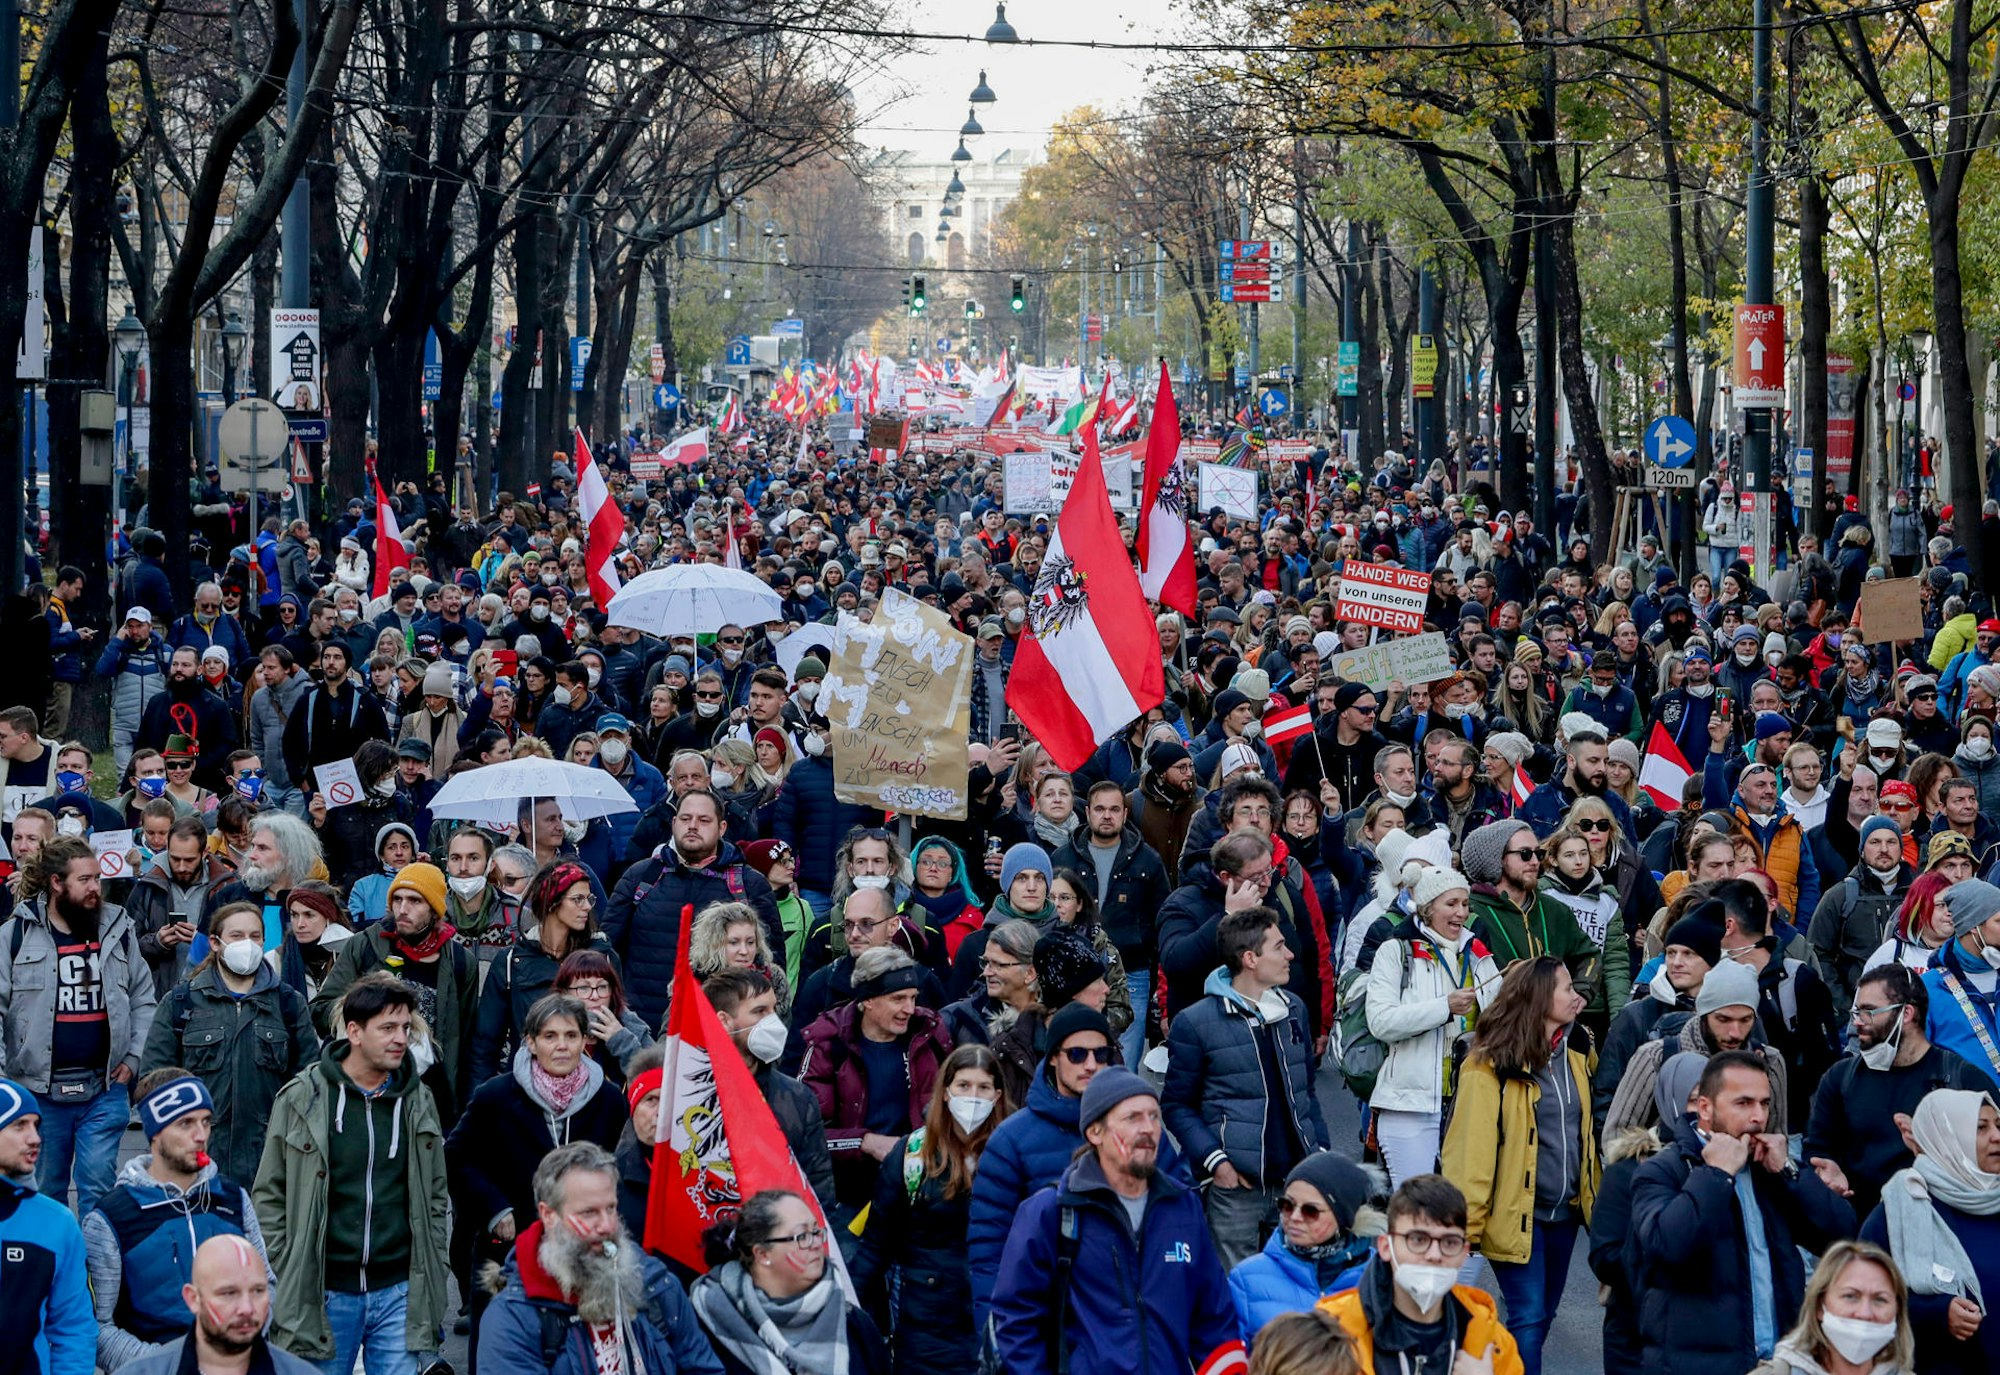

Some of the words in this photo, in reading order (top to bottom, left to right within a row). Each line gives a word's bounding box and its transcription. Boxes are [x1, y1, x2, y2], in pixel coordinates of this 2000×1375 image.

[1739, 309, 1775, 324] PRATER
[294, 339, 310, 347] AUF
[578, 345, 592, 365] P
[733, 345, 744, 360] P
[293, 369, 311, 377] WEG
[290, 426, 321, 436] bastraße
[1652, 470, 1689, 485] 120m
[1345, 563, 1394, 583] HÄNDE
[1397, 572, 1429, 589] WEG
[1344, 587, 1367, 598] von
[1371, 591, 1422, 608] unseren
[1340, 603, 1420, 629] KINDERN
[842, 732, 867, 748] UM
[860, 743, 930, 784] Mensch
[842, 767, 871, 786] ZU
[1175, 1241, 1192, 1264] DS
